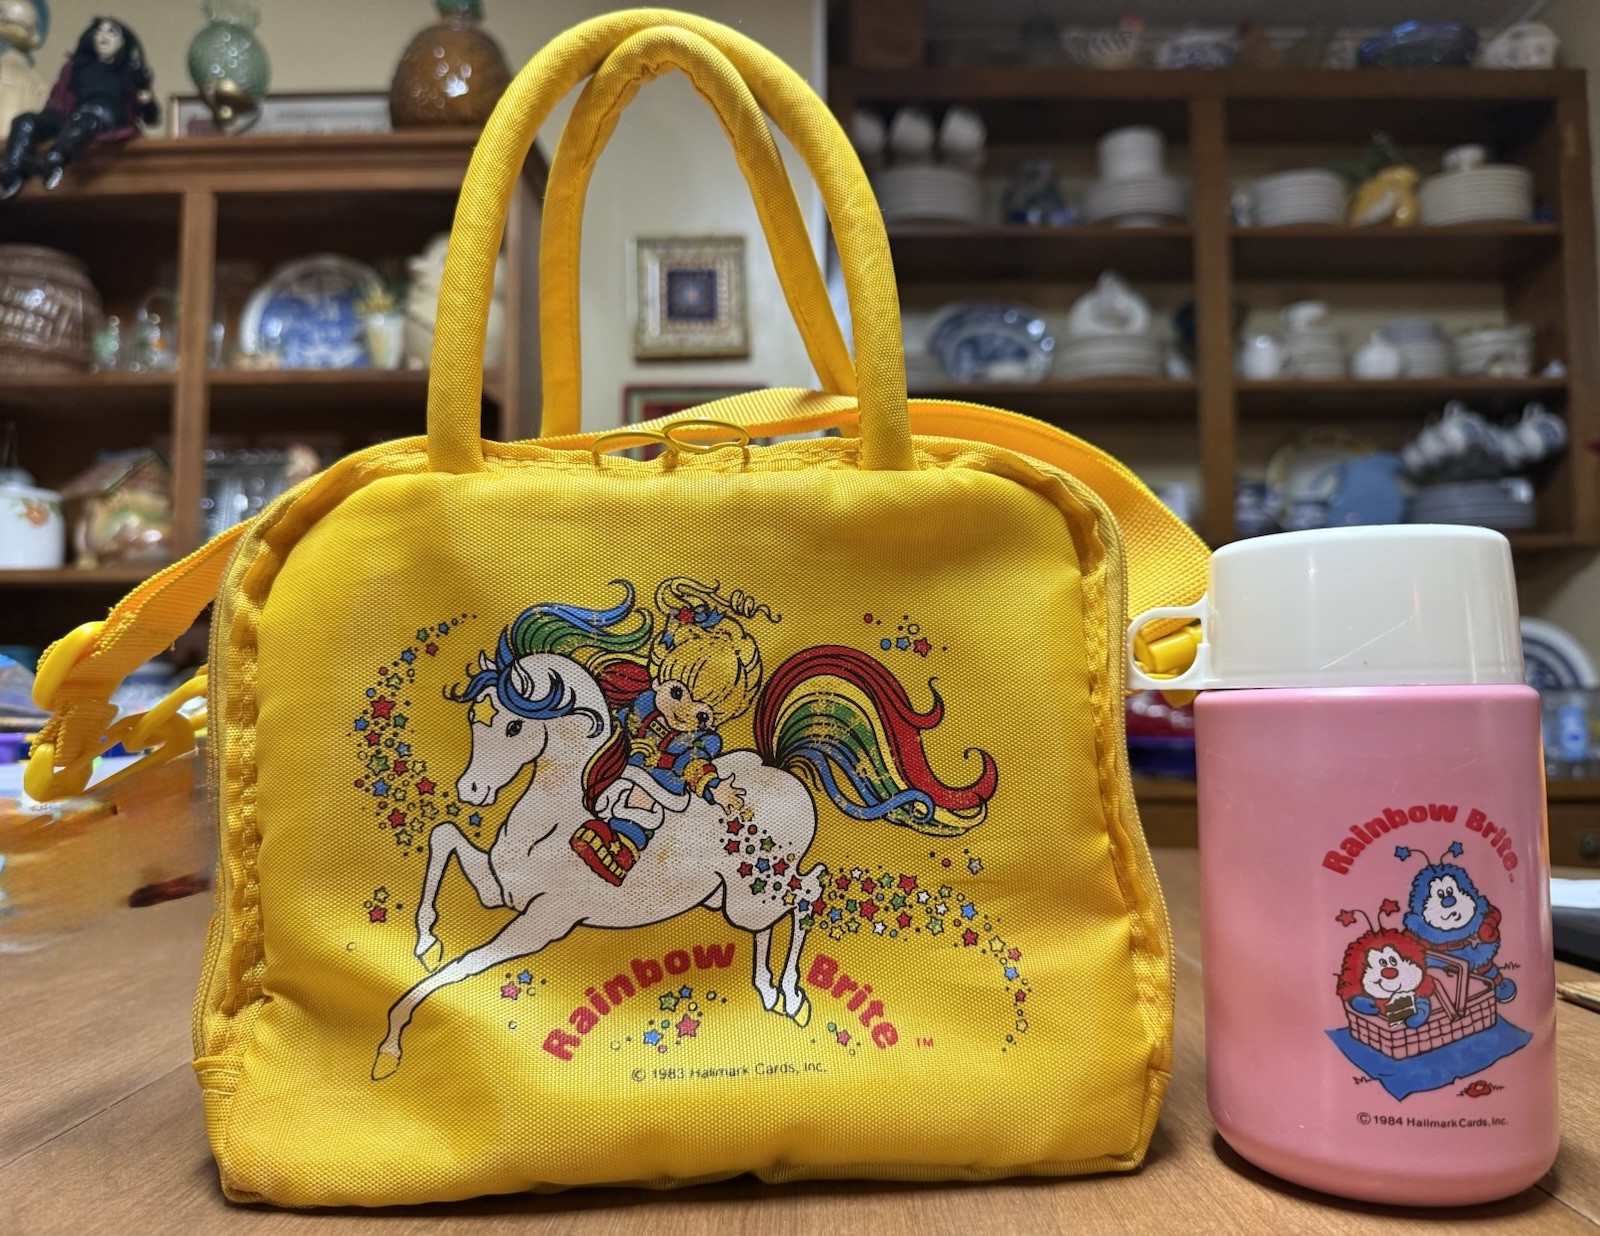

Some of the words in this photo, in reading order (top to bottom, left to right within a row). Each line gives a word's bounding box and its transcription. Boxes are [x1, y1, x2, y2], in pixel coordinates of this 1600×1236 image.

[1321, 803, 1459, 875] Rainbow
[1464, 808, 1519, 871] Brite
[542, 942, 736, 1062] Rainbow
[806, 953, 899, 1050] Brite
[915, 1036, 934, 1049] TM
[652, 1067, 685, 1081] 1983
[691, 1062, 749, 1079] Hallmark
[755, 1061, 799, 1076] Cards,
[804, 1060, 827, 1074] Inc.
[1373, 1115, 1403, 1126] 1984
[1406, 1117, 1458, 1129] Hallmark
[1491, 1116, 1509, 1126] Inc.
